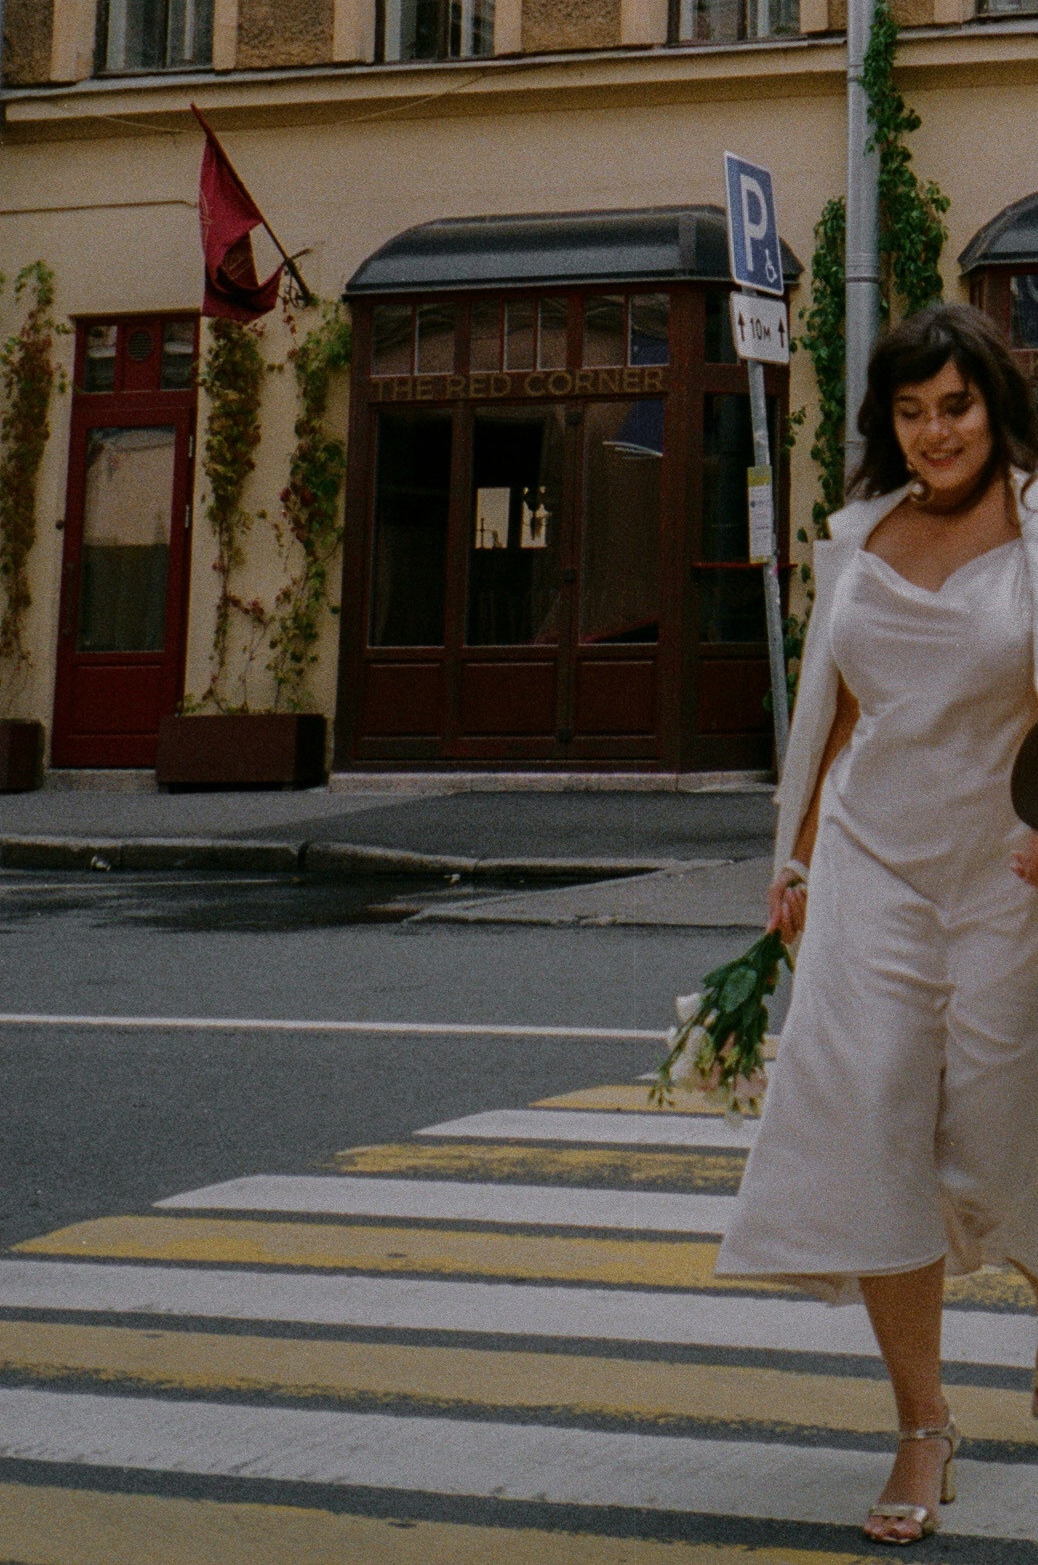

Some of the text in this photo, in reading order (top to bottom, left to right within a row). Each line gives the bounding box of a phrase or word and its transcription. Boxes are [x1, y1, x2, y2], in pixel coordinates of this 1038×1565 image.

[739, 173, 768, 272] P
[371, 367, 665, 402] THE RED CORNER
